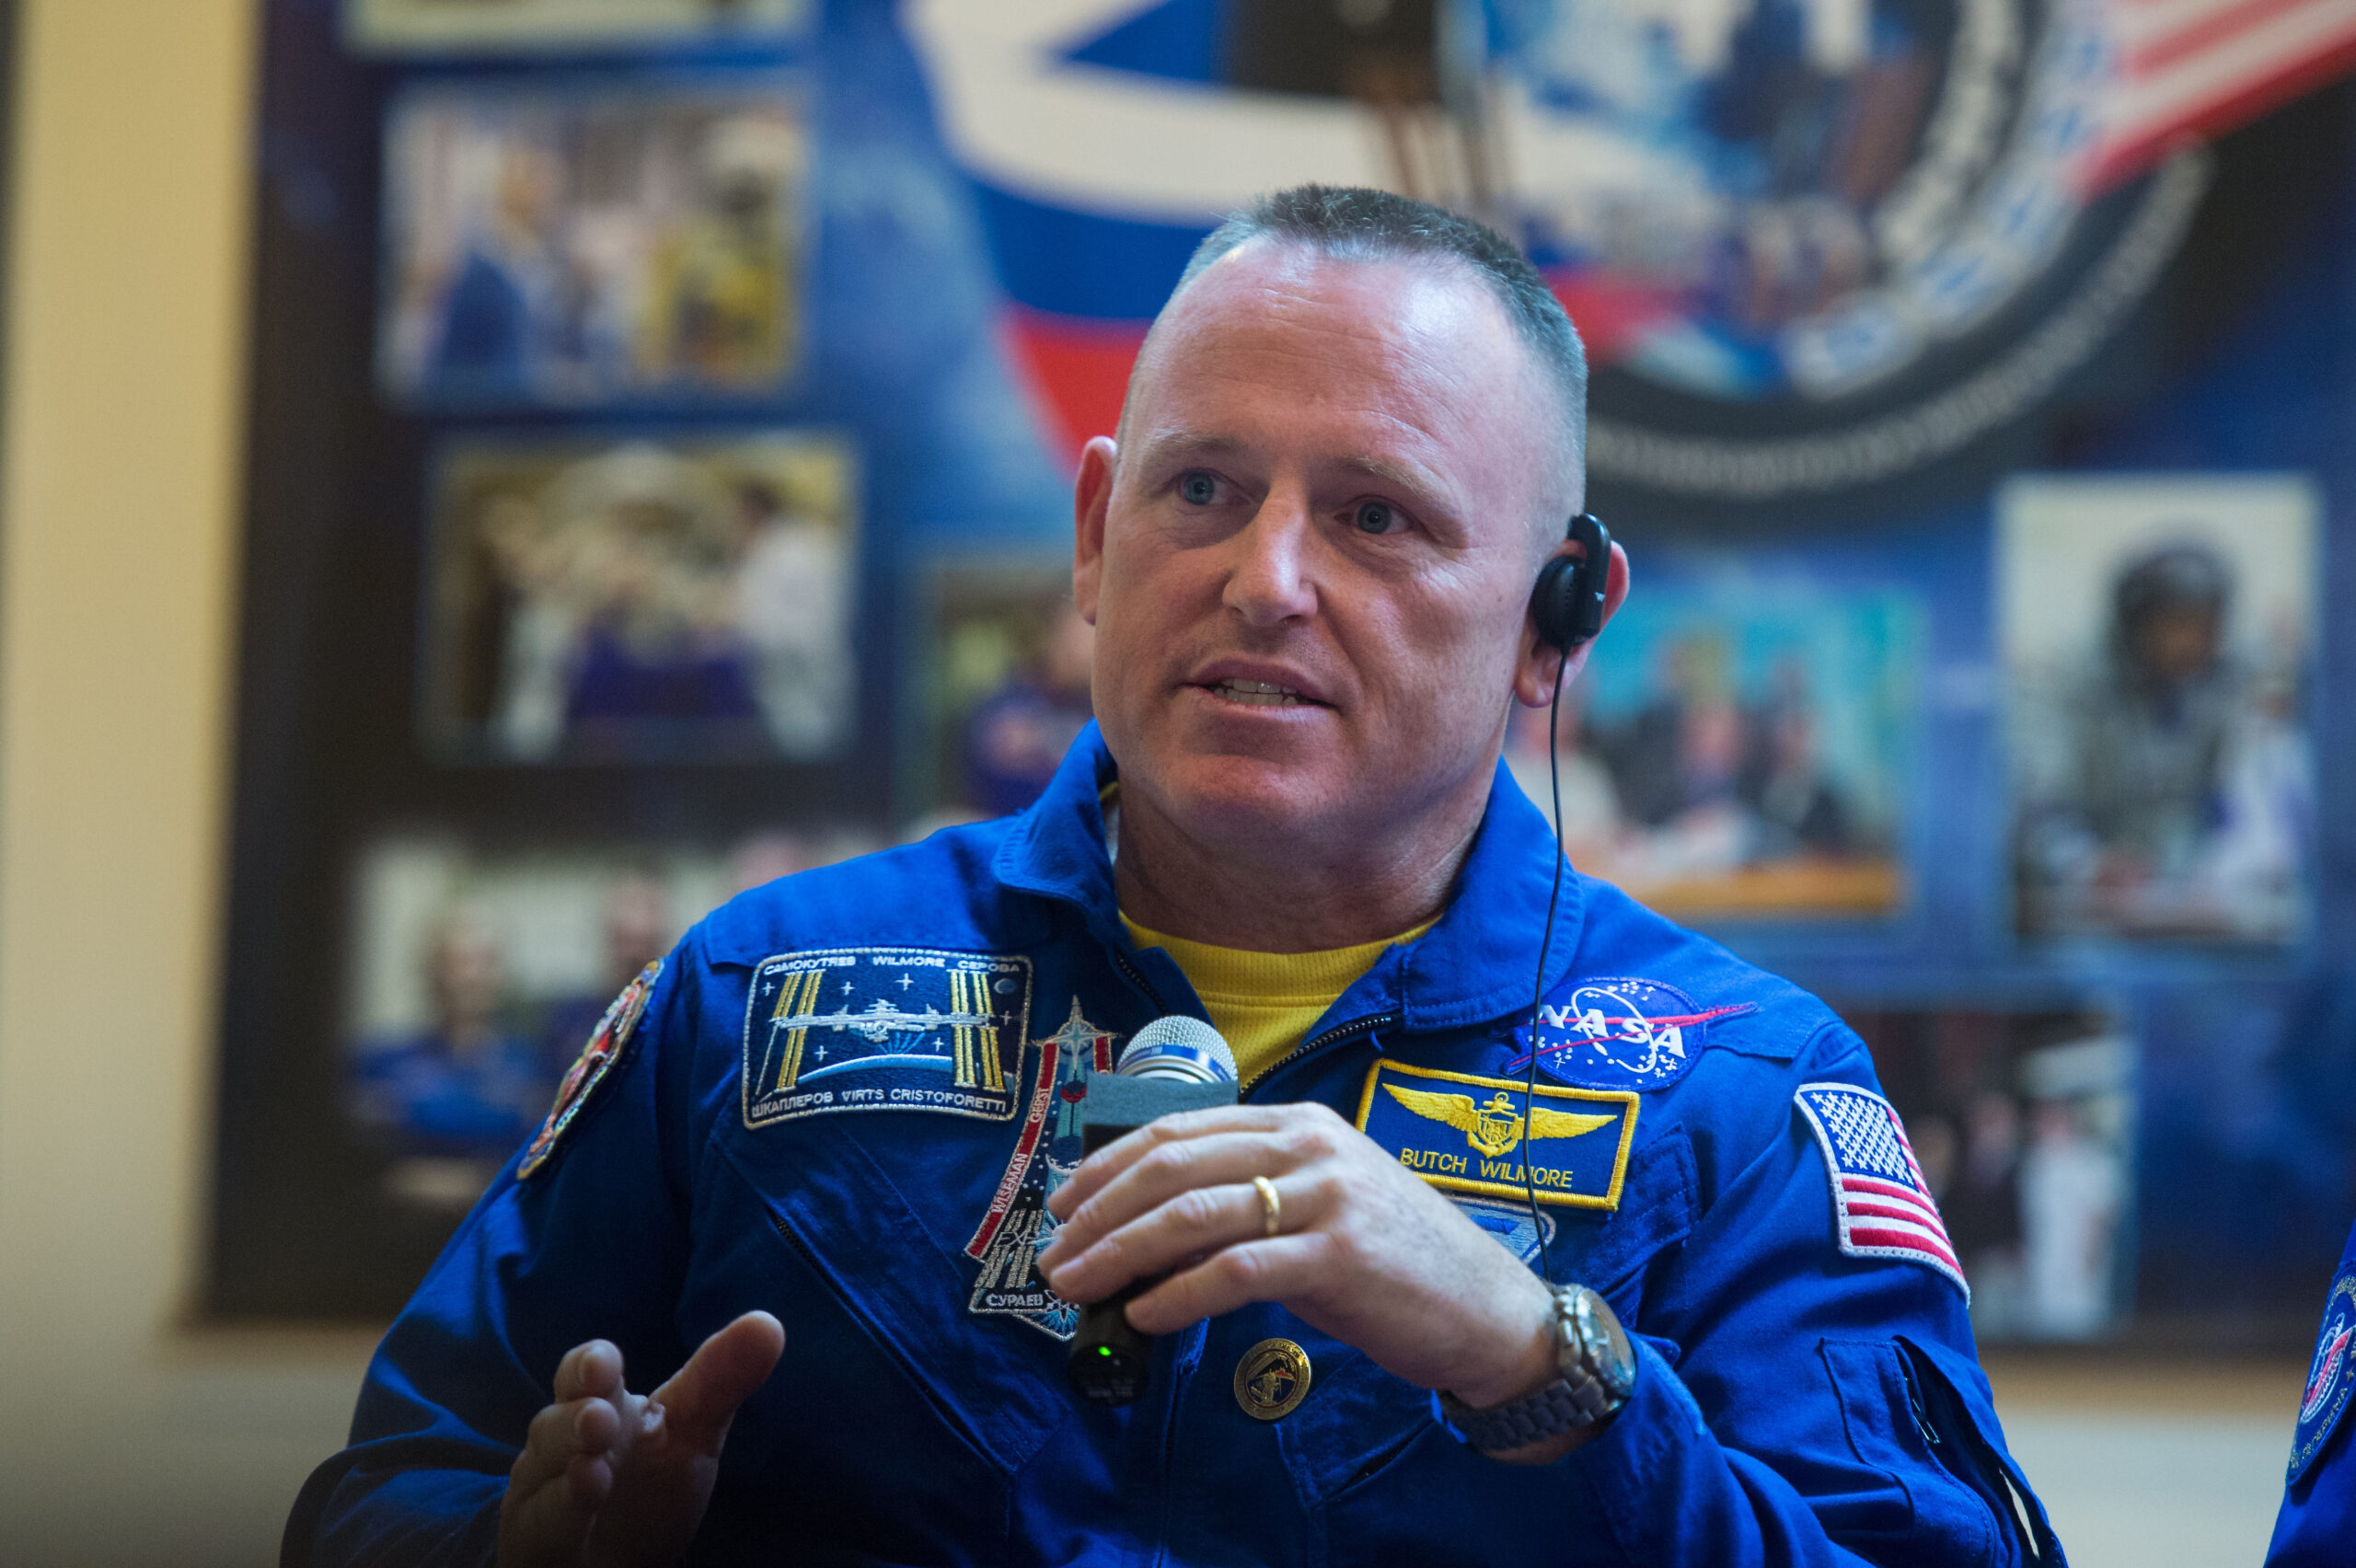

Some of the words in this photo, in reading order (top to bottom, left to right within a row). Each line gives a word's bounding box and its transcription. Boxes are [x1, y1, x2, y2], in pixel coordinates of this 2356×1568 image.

[872, 955, 946, 968] WILMORE
[1530, 1004, 1687, 1059] NASA
[841, 1089, 884, 1102] VIRTS
[890, 1088, 1007, 1113] CRISTOFORETTI
[991, 1153, 1029, 1213] WISEMAN
[1030, 1087, 1049, 1124] GERST
[1399, 1147, 1468, 1174] BUTCH
[1480, 1159, 1574, 1189] WILMORE
